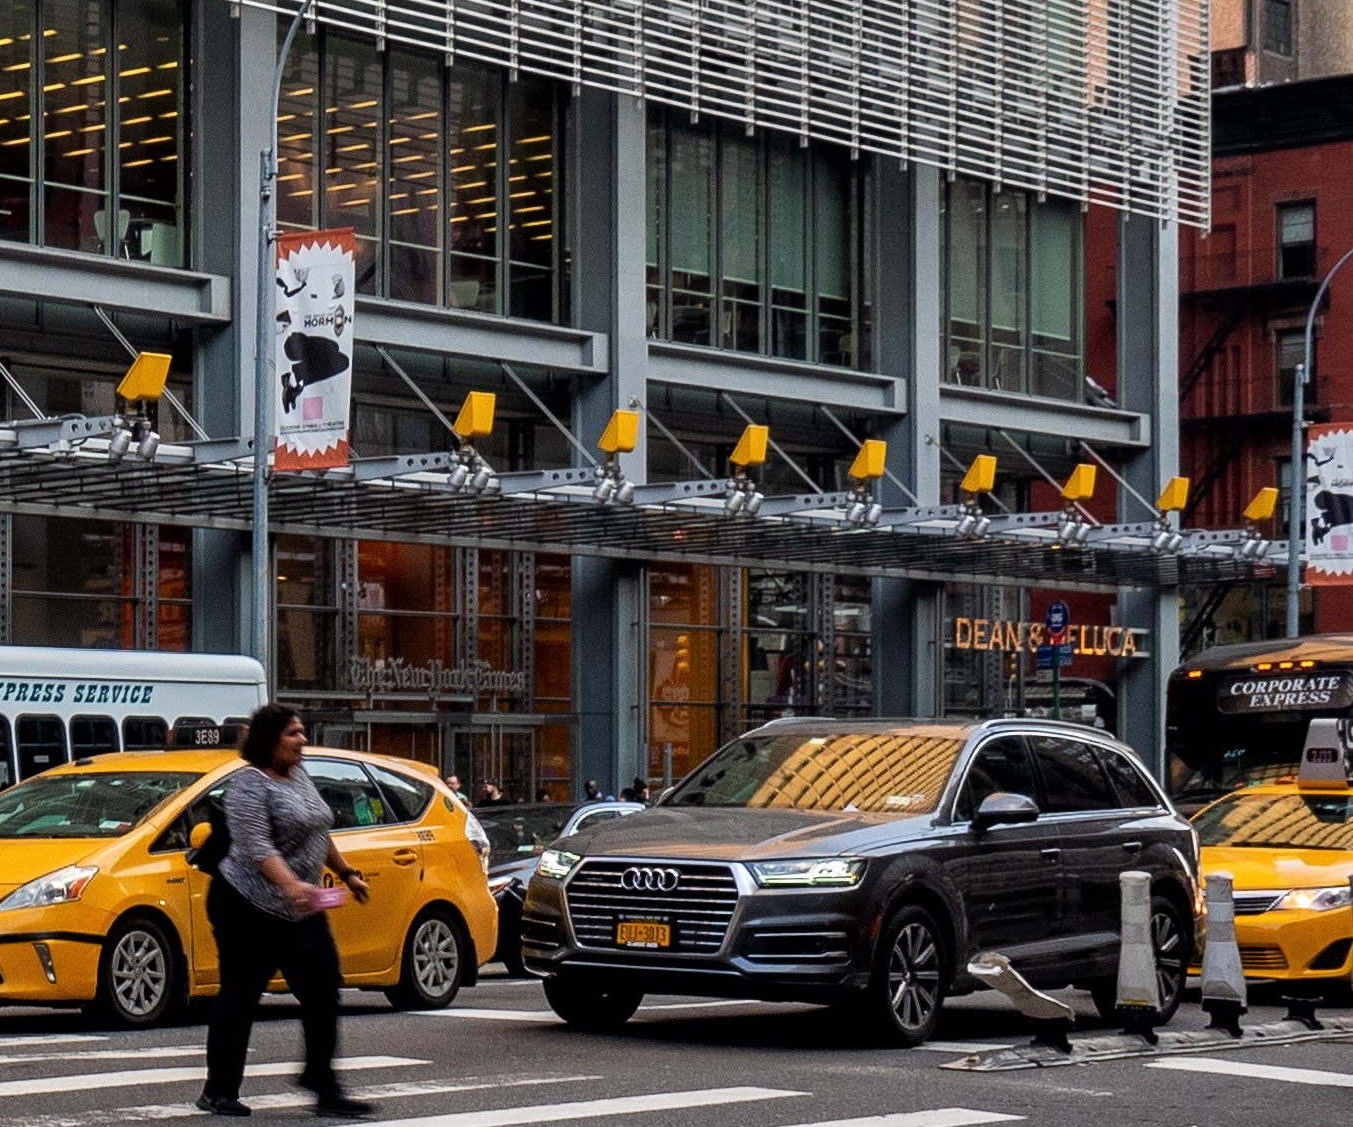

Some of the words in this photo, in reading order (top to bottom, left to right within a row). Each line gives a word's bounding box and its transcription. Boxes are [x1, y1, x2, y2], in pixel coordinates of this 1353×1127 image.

[956, 617, 1022, 652] DEAN
[1029, 623, 1043, 653] &
[1050, 625, 1137, 657] ELUCA
[73, 684, 153, 704] SERVICE
[1231, 676, 1340, 696] CORPORATE
[1249, 690, 1331, 708] EXPRESS
